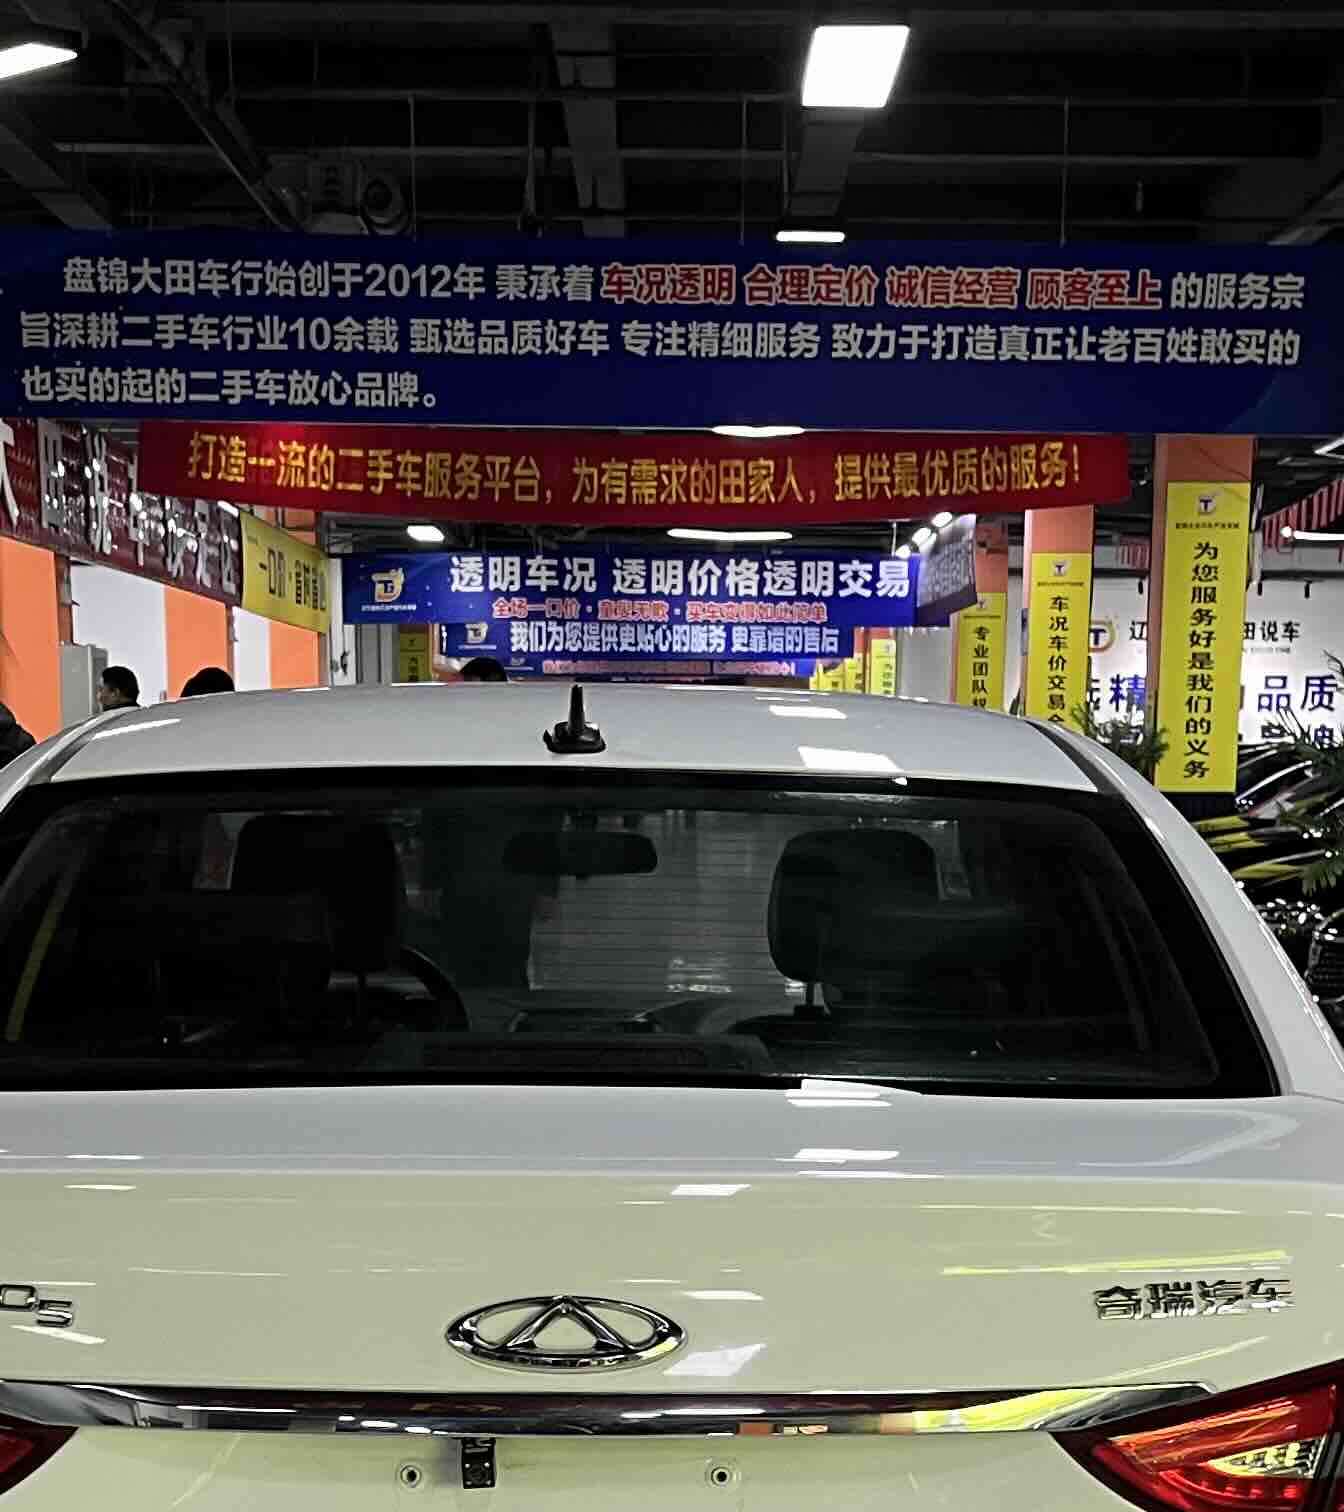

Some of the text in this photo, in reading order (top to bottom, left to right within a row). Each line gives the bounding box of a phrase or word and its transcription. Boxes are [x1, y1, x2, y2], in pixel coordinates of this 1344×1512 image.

[62, 256, 1306, 311] 盘锦大田车行始创于2012年 秉承着 车况透明 合理定价 诚信经营 顾客至上 的服务宗
[20, 311, 1301, 367] 旨深耕二手车行业10余载 甄选品质好车 专注精细服务 致力于打造真正让老百姓敢买的
[21, 366, 440, 410] 也买的起的二手车放心品牌。
[449, 555, 598, 594] 透明车况
[612, 557, 911, 599] 透明价格透明交易
[510, 620, 727, 654] 我们为您提供更贴心的服务
[1182, 541, 1219, 780] 为您服务好是我们的义务
[1093, 1277, 1296, 1321] 奇瑞汽车
